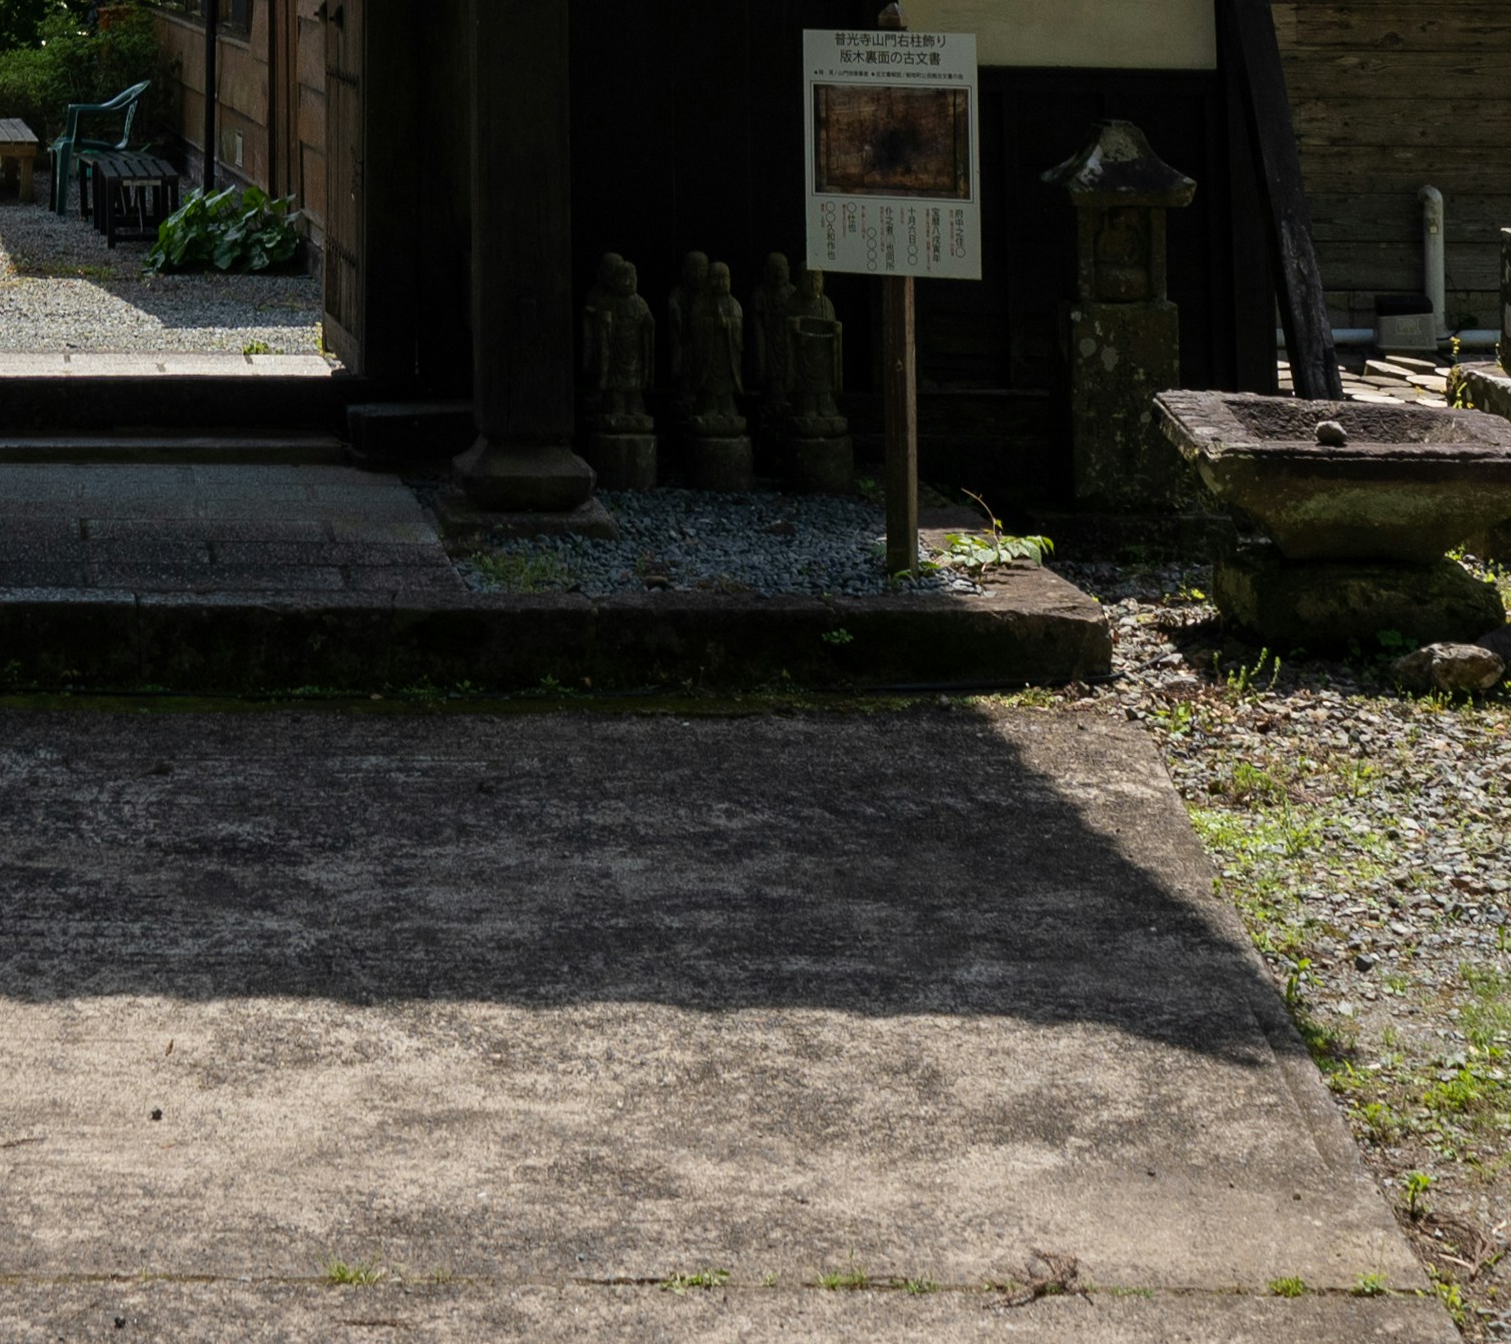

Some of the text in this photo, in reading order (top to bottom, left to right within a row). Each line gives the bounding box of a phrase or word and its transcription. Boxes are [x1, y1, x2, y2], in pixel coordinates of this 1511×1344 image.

[834, 32, 947, 49] 普光寺山門右柱飾り
[839, 49, 941, 66] 版木裏面の古文書
